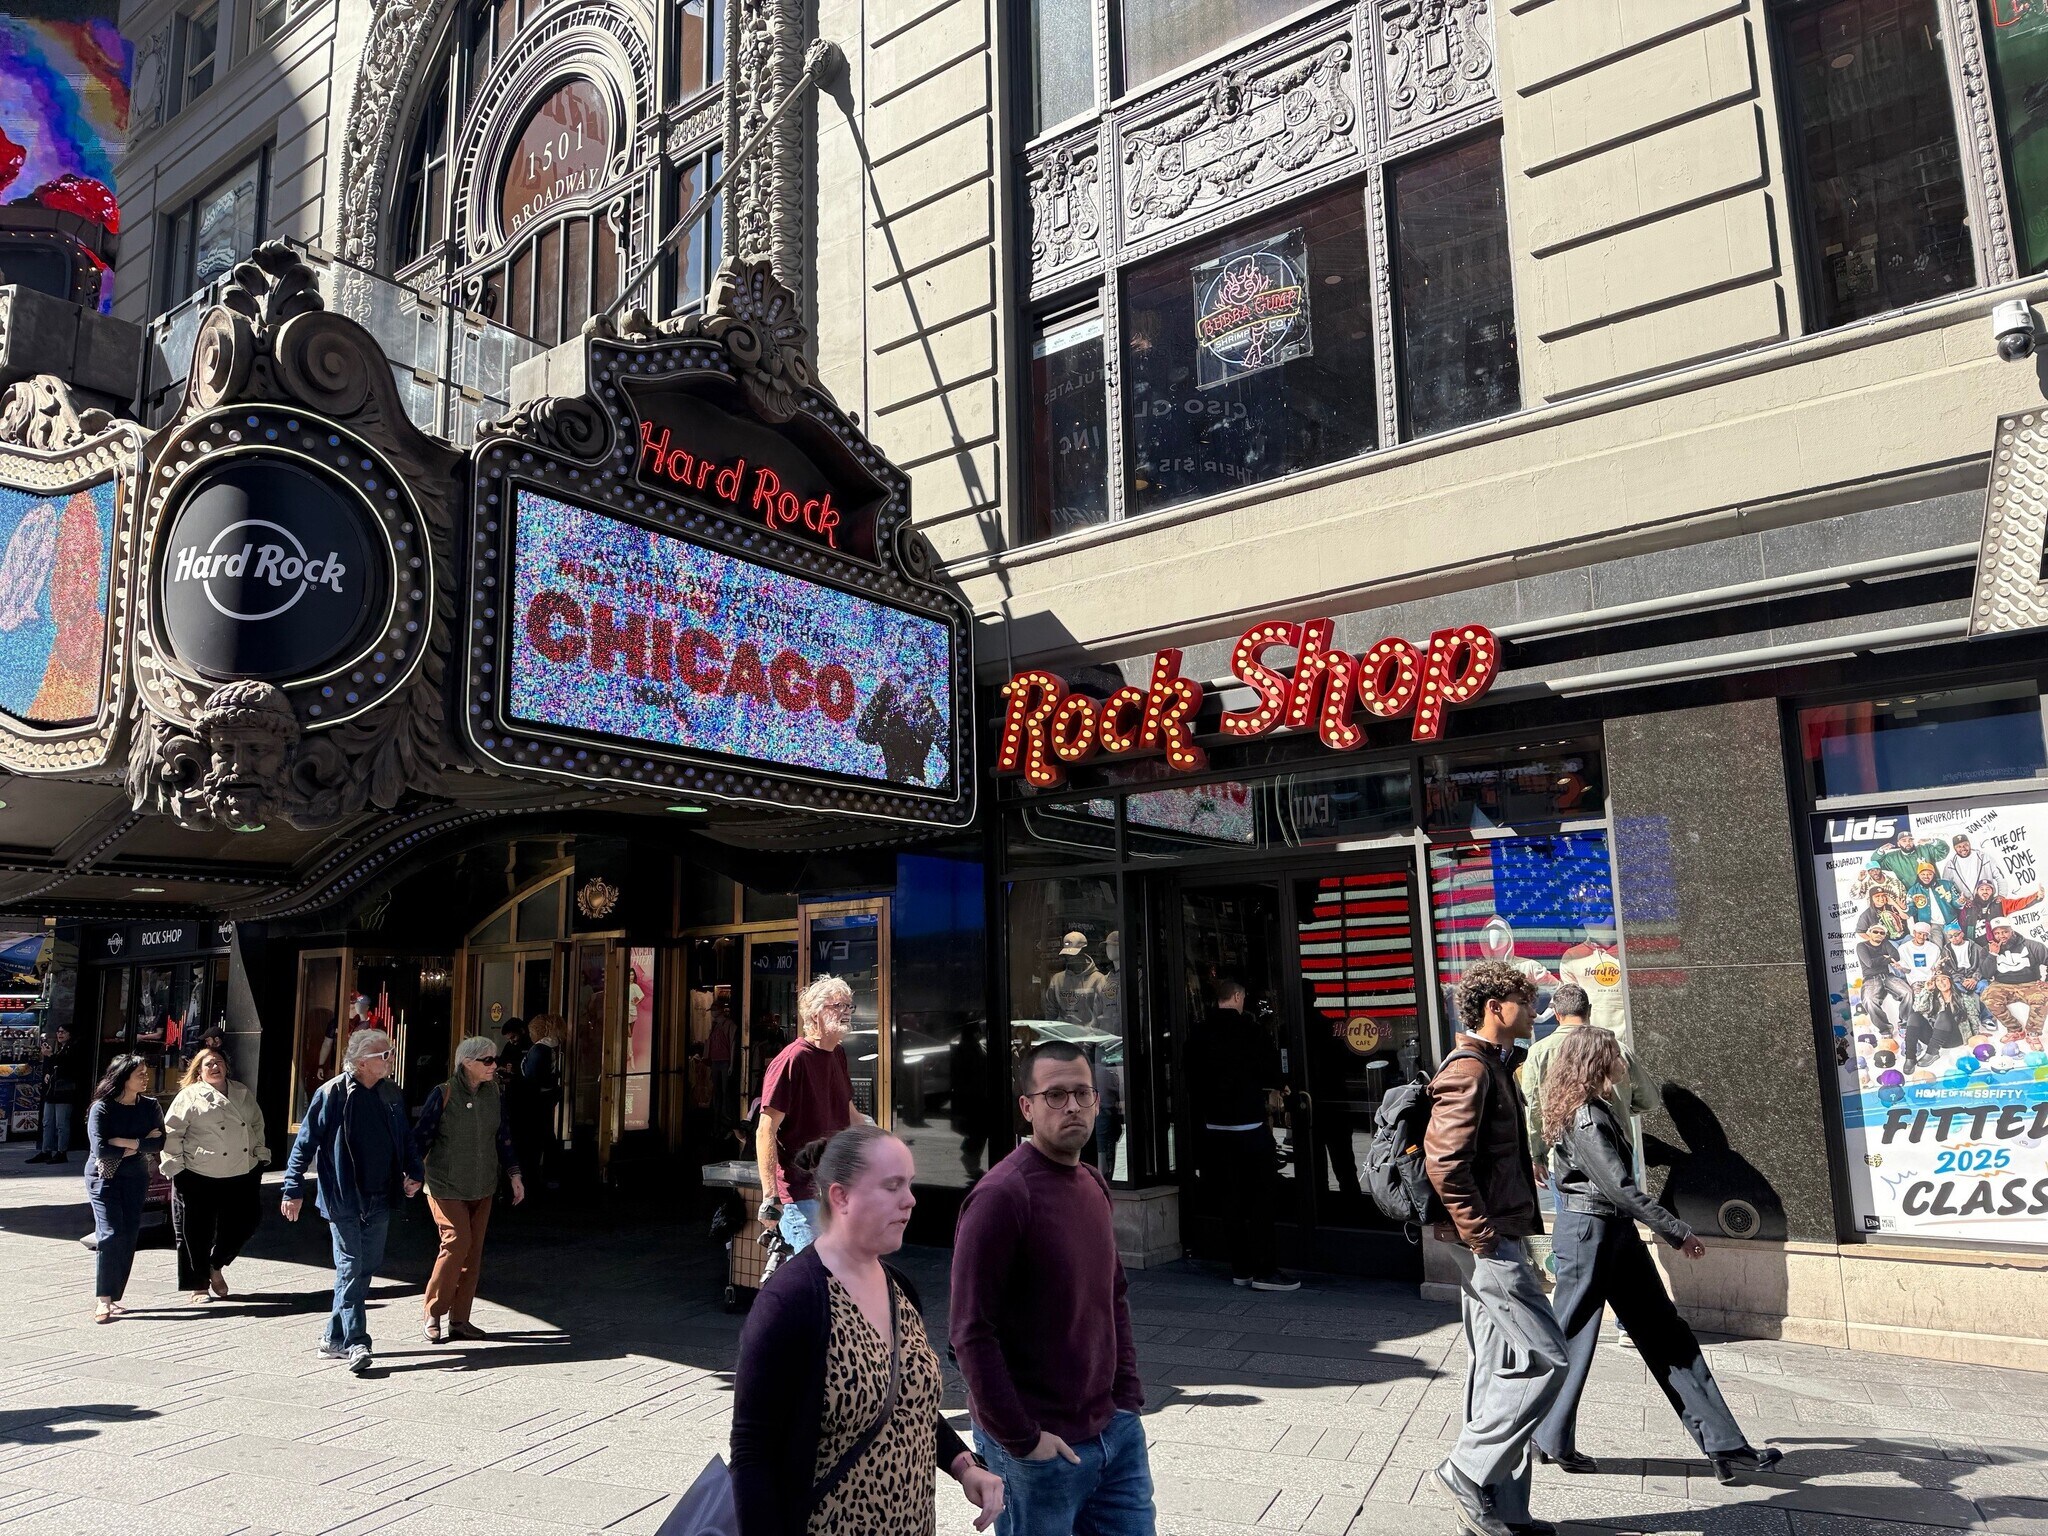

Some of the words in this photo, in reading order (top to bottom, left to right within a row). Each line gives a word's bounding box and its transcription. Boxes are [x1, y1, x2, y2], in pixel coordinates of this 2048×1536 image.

[528, 122, 583, 180] 1501
[511, 167, 599, 232] BROADWAY
[1203, 305, 1251, 337] BUBBA
[1254, 288, 1297, 314] GUMP
[1215, 328, 1251, 350] SHRIMP
[638, 420, 743, 503] Hard
[753, 468, 841, 549] Rock
[174, 543, 252, 583] Hard
[254, 543, 346, 593] Rock
[527, 589, 856, 723] CHICAGO
[997, 647, 1206, 788] Rock
[1219, 616, 1502, 750] Shop
[1823, 814, 1898, 843] Lids
[1965, 820, 1983, 834] JON
[1980, 809, 1998, 825] STAN
[1991, 834, 2008, 849] THE
[2009, 826, 2027, 846] OFF
[2001, 843, 2018, 855] the
[2003, 848, 2036, 875] DOME
[2015, 867, 2036, 887] POD
[2012, 910, 2041, 926] JAETIPS
[141, 930, 161, 946] ROCK
[162, 928, 182, 944] SHOP
[1584, 966, 1607, 977] Hard
[1608, 966, 1620, 977] Ro
[1332, 1022, 1361, 1037] Hard
[1363, 1022, 1393, 1039] Rock
[1915, 1089, 1947, 1099] HOME
[1948, 1090, 1957, 1098] OF
[1974, 1089, 2024, 1099] 59FIFTY
[1934, 1148, 2011, 1175] 2025
[1902, 1178, 2048, 1216] CLASS
